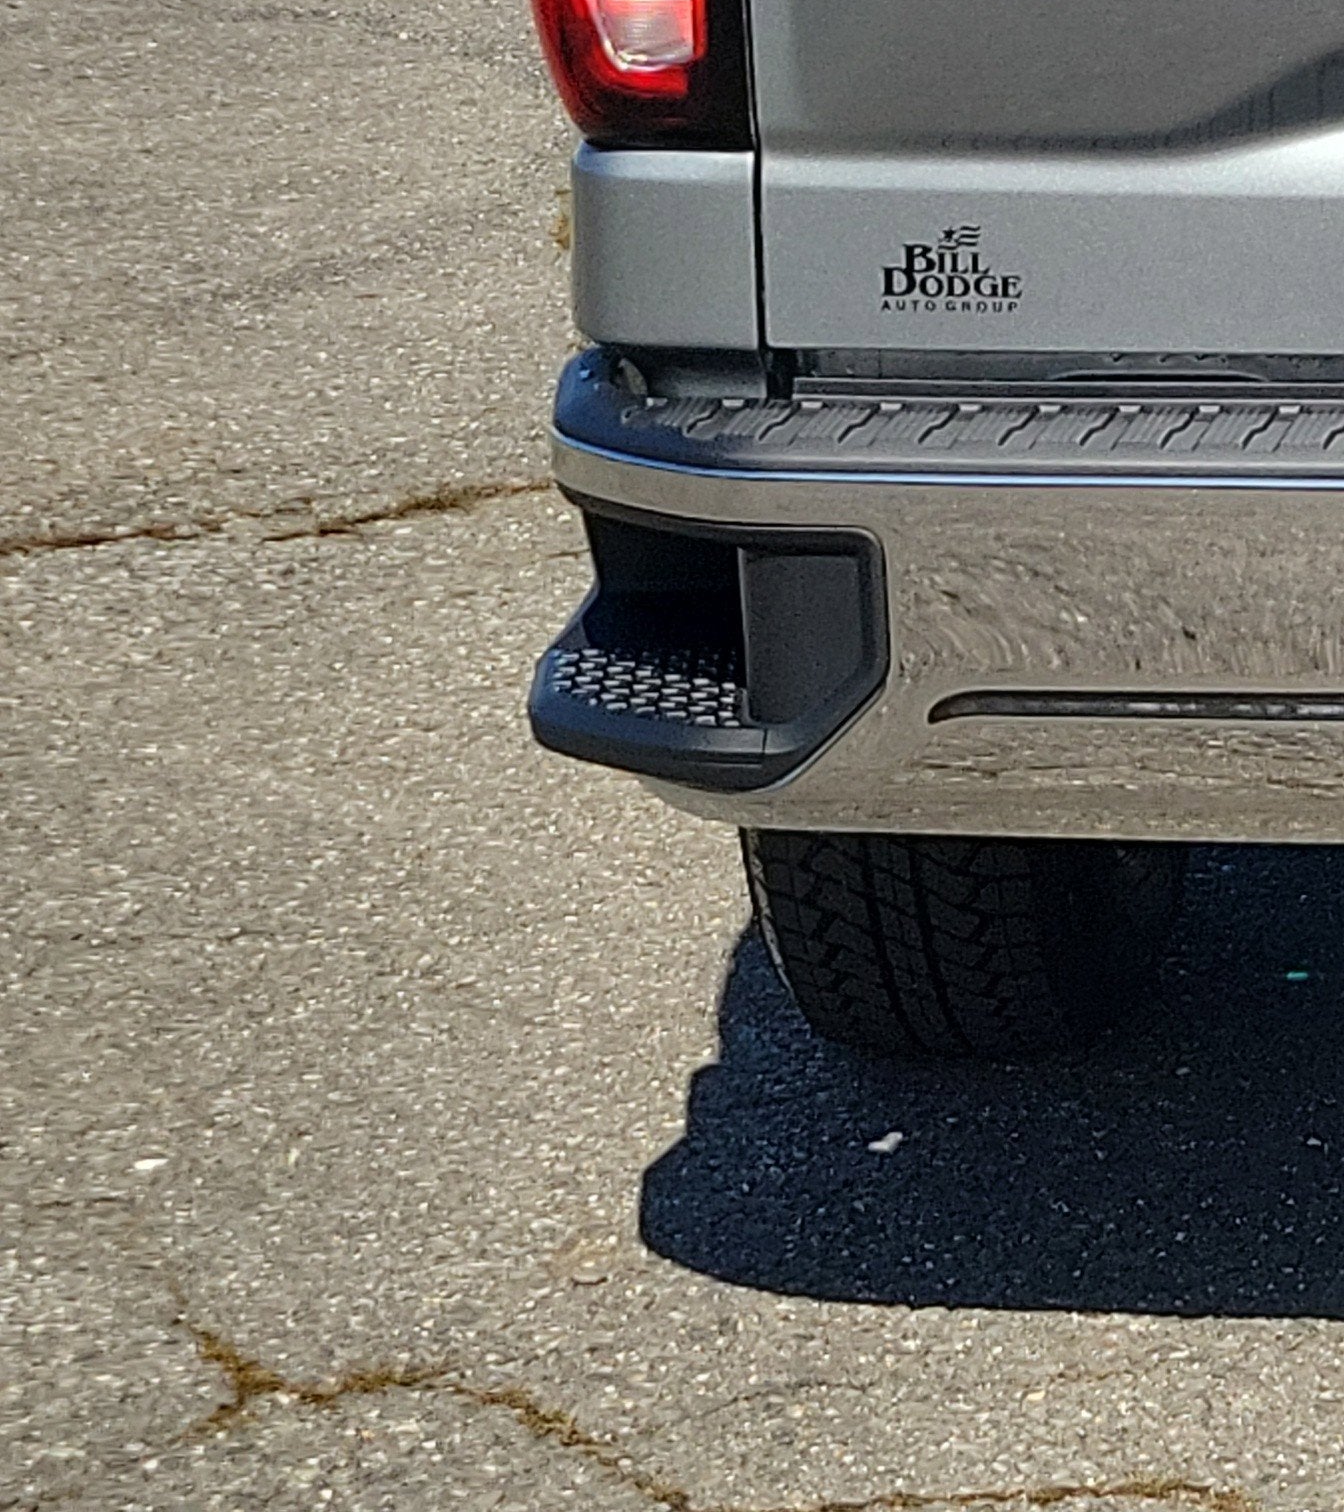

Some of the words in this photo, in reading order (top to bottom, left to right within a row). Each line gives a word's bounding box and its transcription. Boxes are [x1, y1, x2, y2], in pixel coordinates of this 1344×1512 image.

[903, 243, 990, 274] BILL
[882, 266, 1022, 298] DODGE
[881, 299, 936, 312] AUTO
[945, 299, 1018, 313] GROUP
